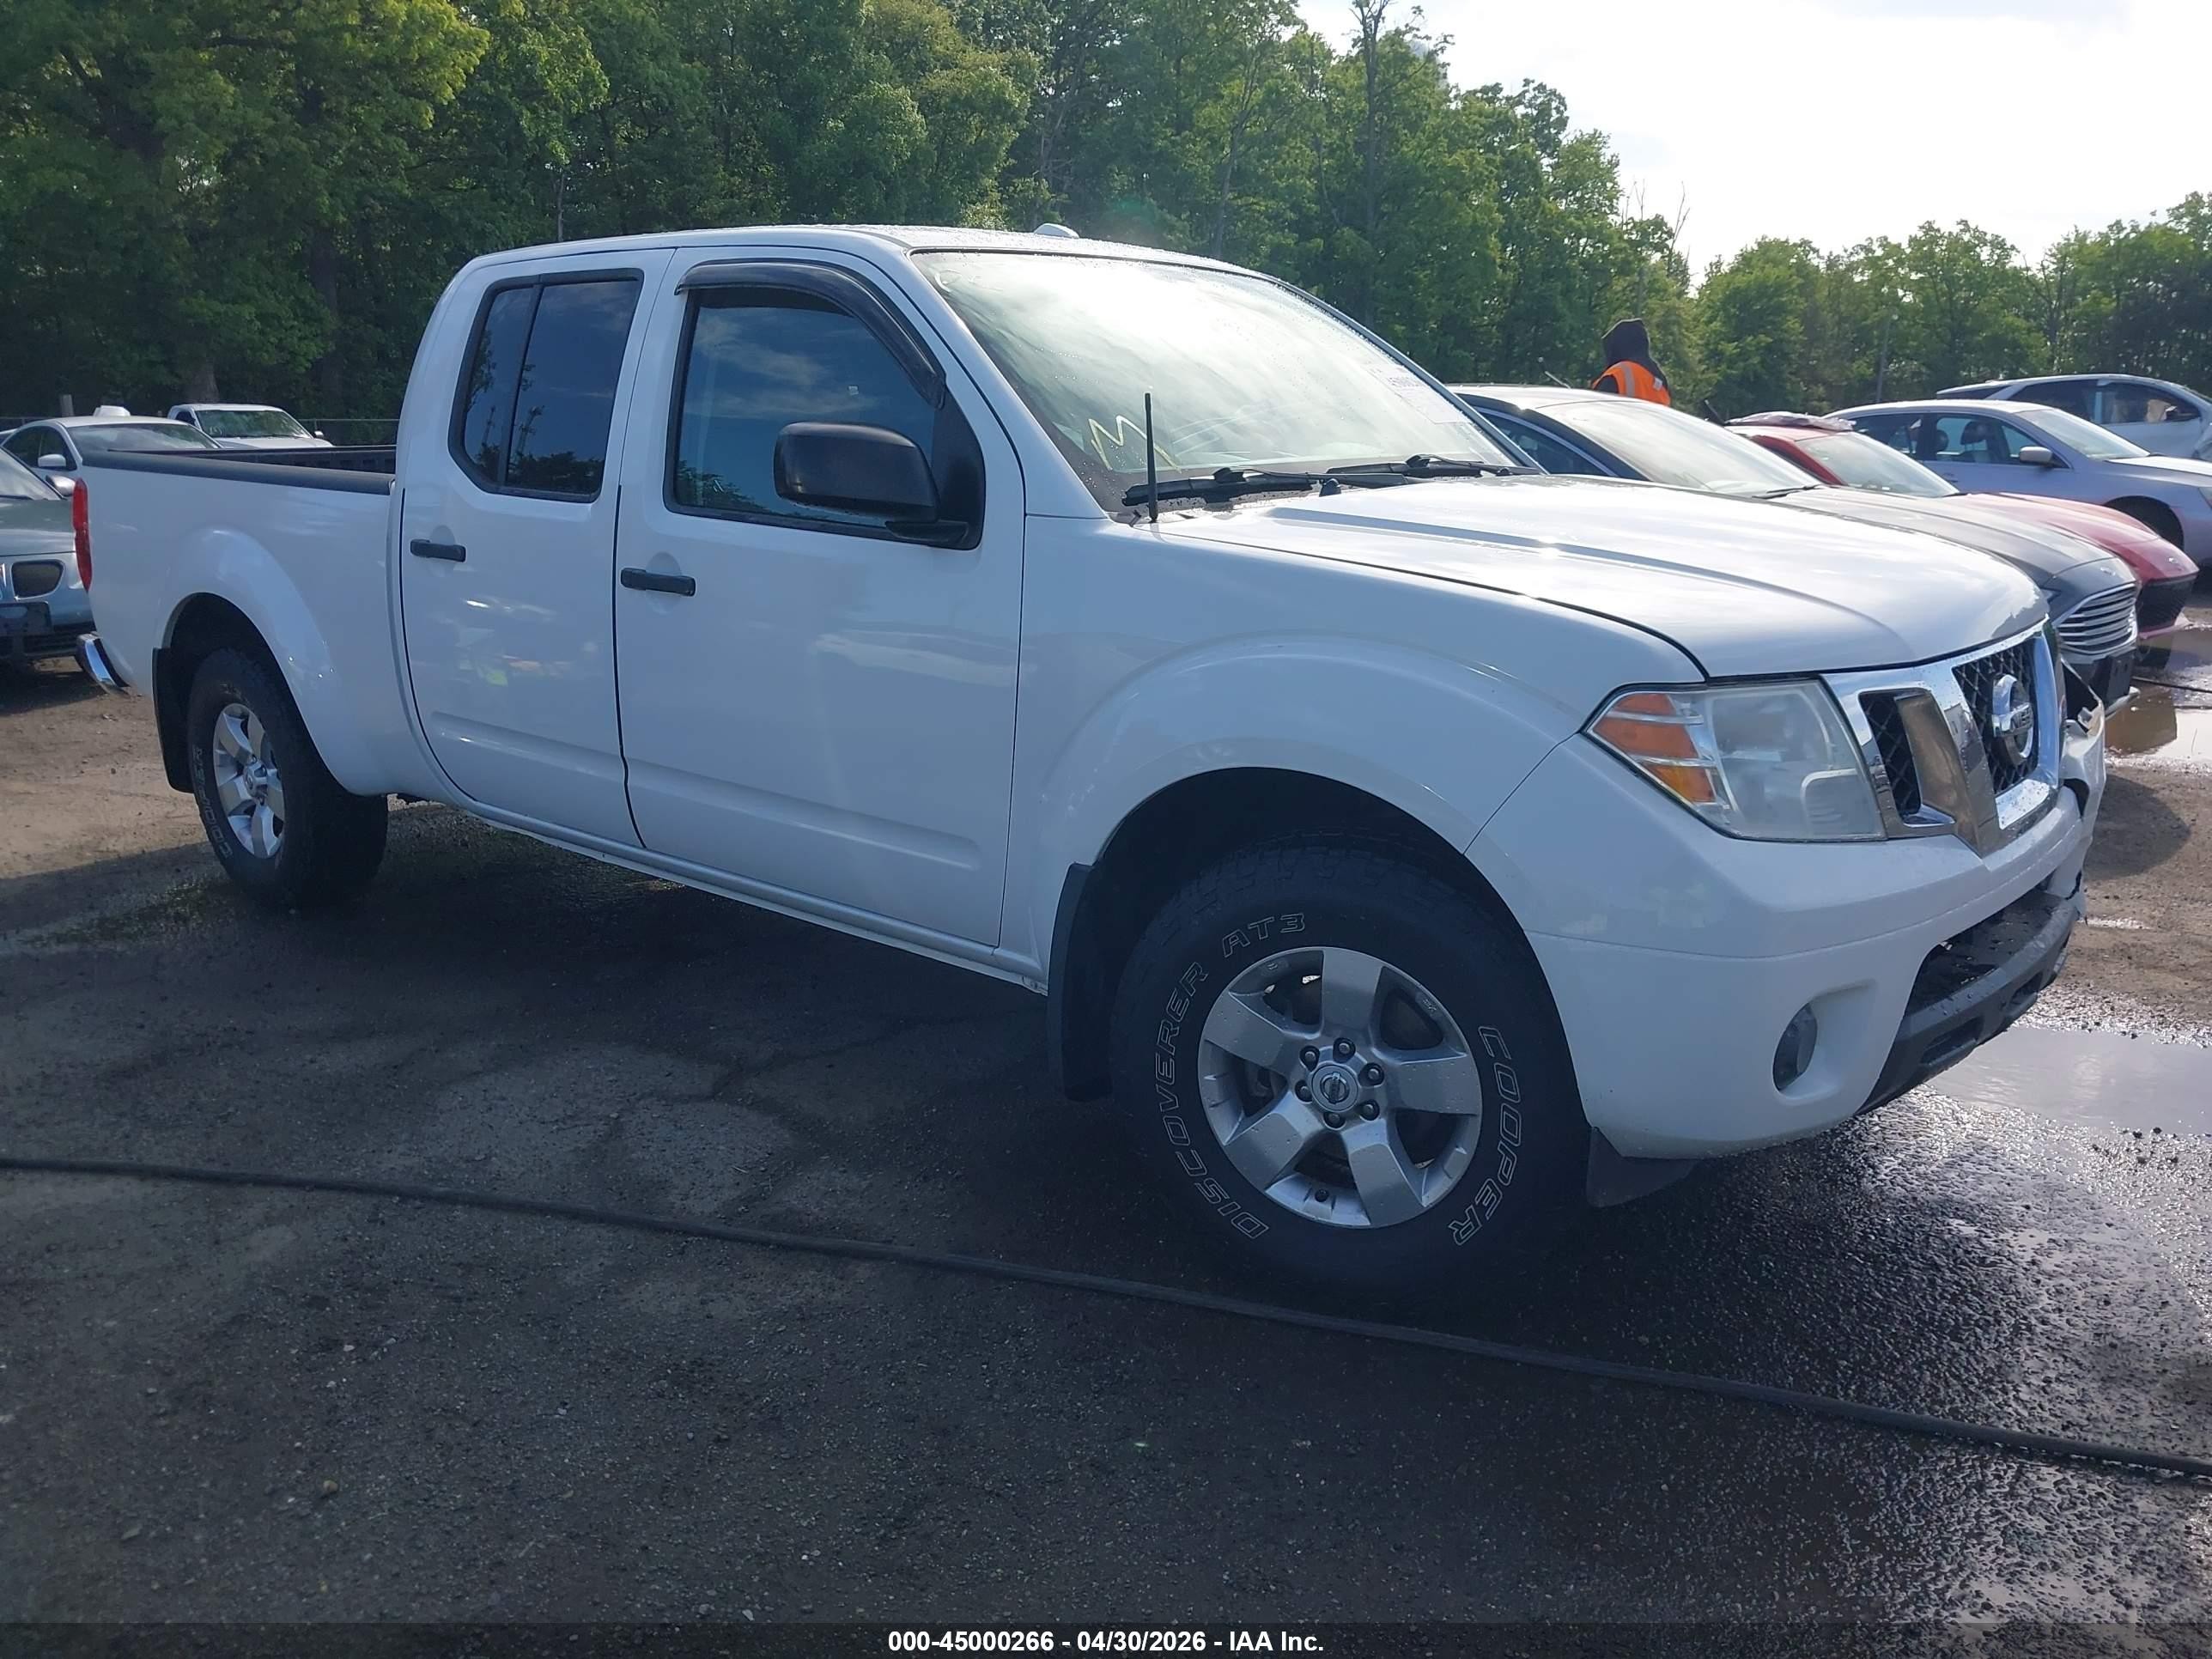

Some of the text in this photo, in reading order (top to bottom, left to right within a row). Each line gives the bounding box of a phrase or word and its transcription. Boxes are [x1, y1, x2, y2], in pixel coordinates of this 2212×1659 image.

[1155, 912, 1306, 1239] DISCOVERER AT3
[1447, 1025, 1523, 1246] COOPER
